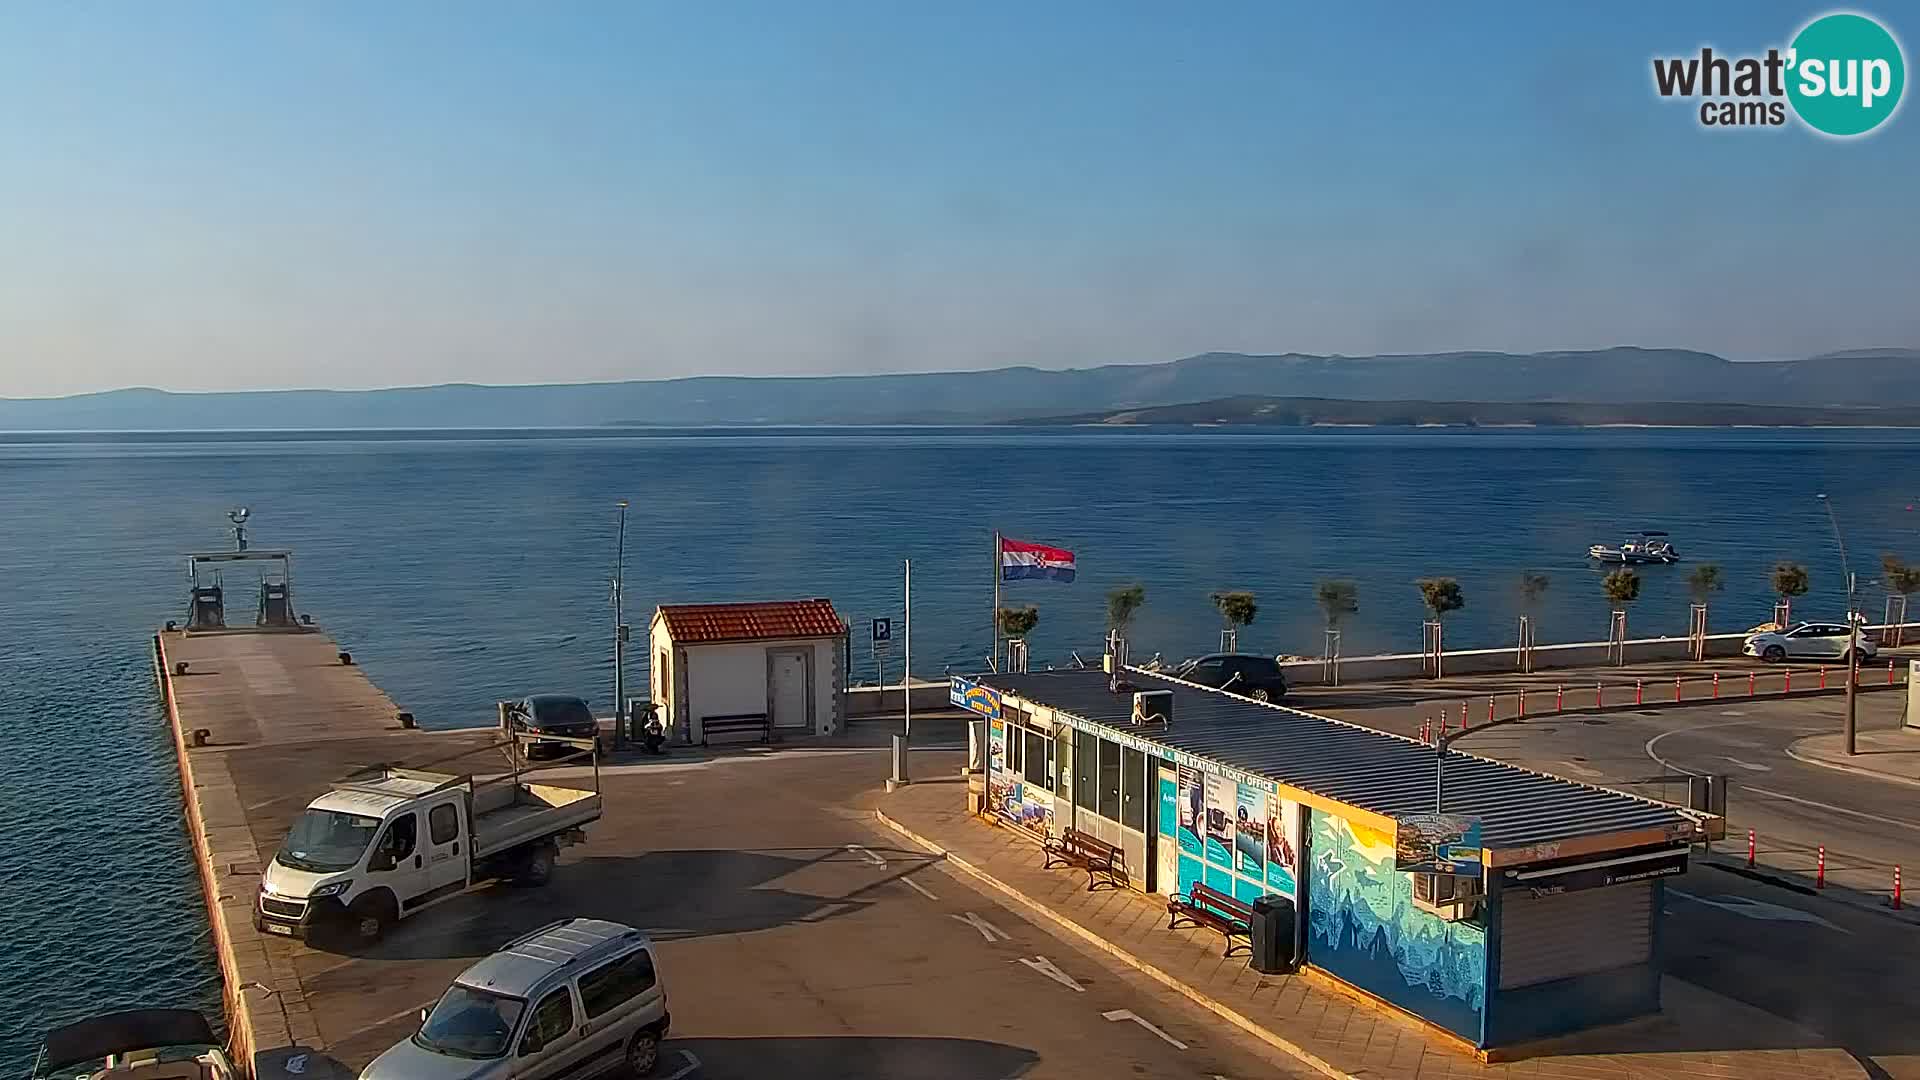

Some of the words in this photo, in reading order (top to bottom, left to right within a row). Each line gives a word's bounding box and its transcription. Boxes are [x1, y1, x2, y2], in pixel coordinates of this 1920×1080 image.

[876, 621, 887, 638] P
[1098, 729, 1135, 750] AUTOBUSNA
[1136, 741, 1164, 758] POSTAJA
[1174, 752, 1188, 766] BUS
[1189, 757, 1219, 775] STATION
[1221, 768, 1245, 784] TICKET
[1247, 777, 1273, 793] OFFICE
